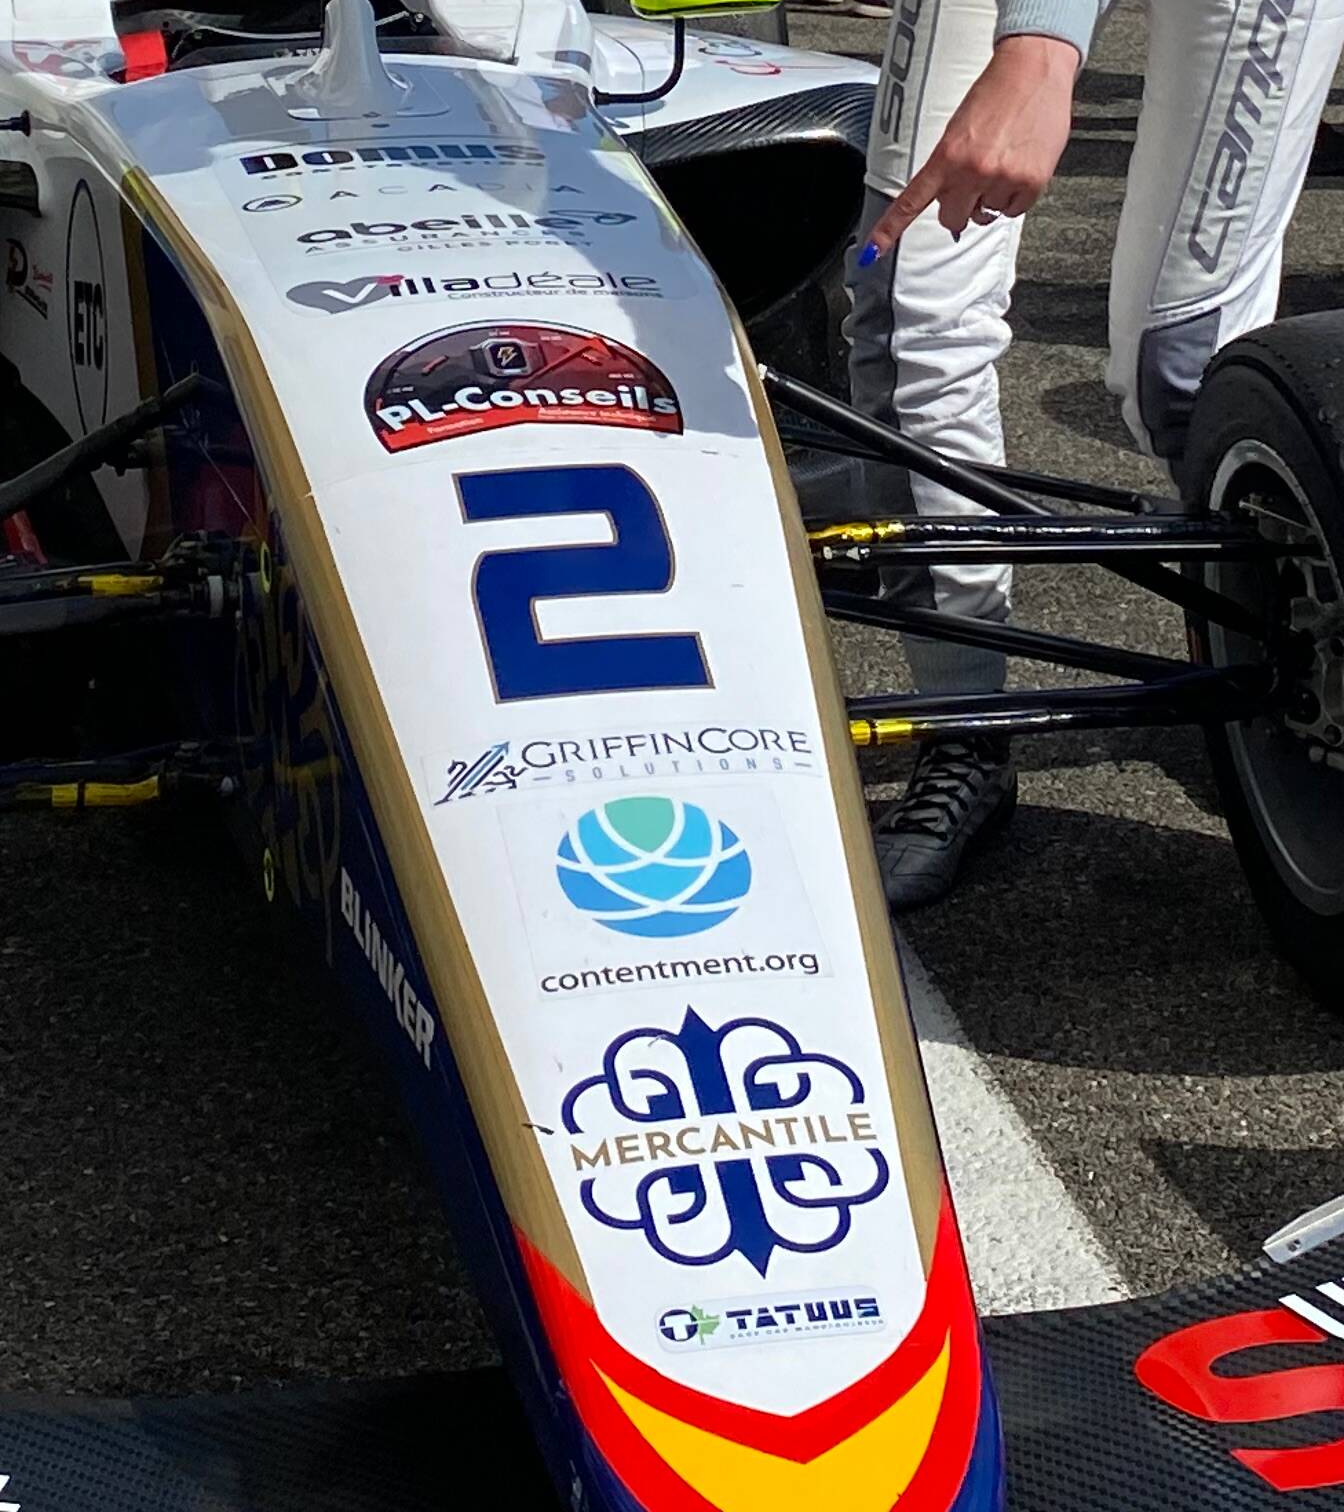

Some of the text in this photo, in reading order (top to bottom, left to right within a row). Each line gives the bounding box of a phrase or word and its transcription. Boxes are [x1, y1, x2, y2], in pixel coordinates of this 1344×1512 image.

[296, 213, 585, 244] abeille
[73, 279, 105, 371] ETC
[376, 384, 679, 432] PL-Conseils
[452, 462, 716, 705] 2
[565, 757, 784, 784] SOLUTIONS
[340, 866, 436, 1072] BLINKER
[540, 951, 820, 993] contentment.org
[569, 1111, 878, 1172] MERCANTILE
[725, 1297, 881, 1330] TATUUS
